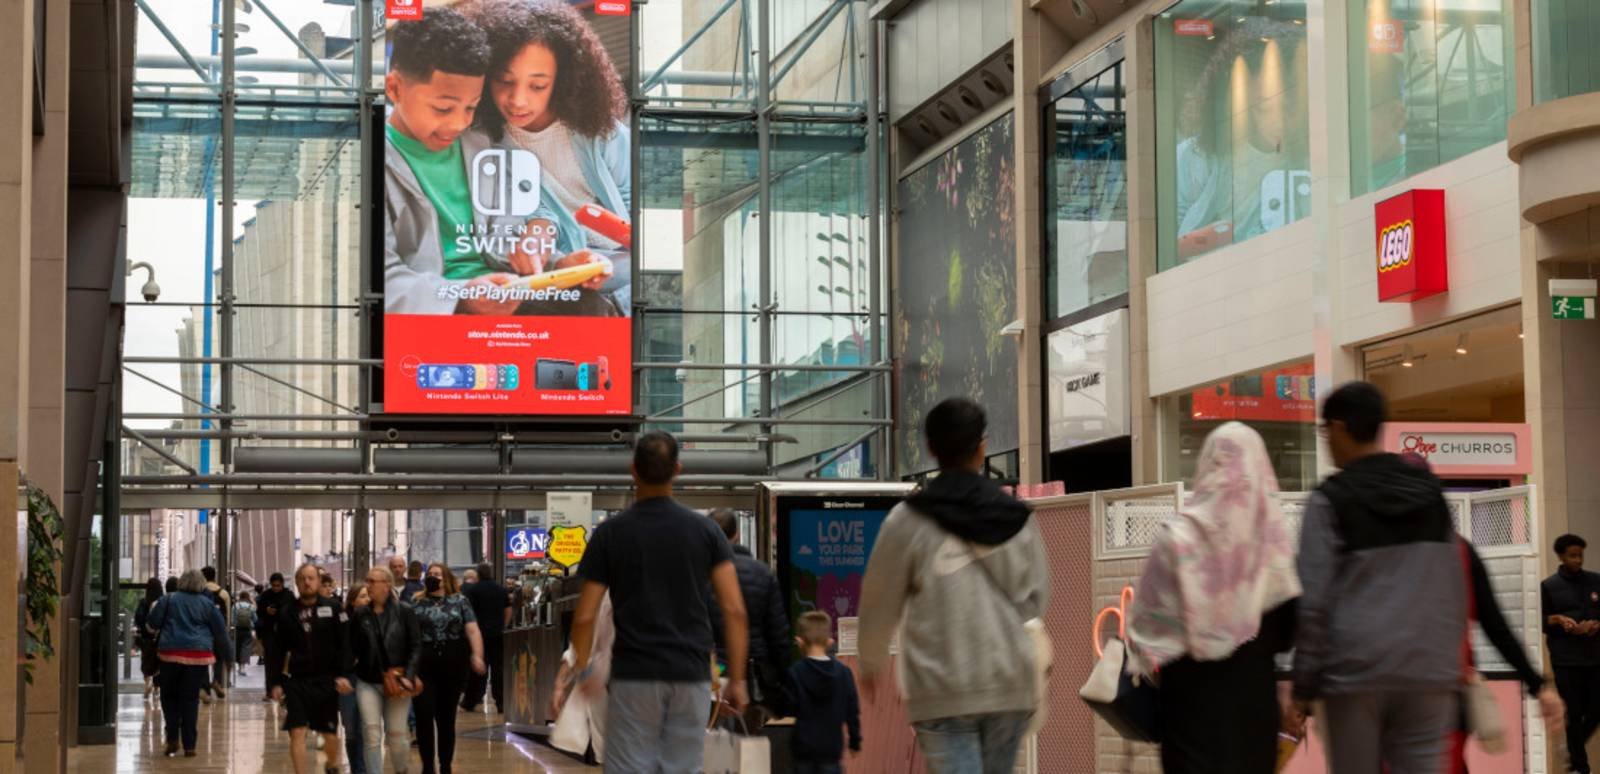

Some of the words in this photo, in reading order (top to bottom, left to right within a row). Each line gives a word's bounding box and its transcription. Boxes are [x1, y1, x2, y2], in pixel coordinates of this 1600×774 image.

[456, 223, 557, 235] NINTENDO
[456, 236, 557, 255] SWITCH
[1380, 223, 1412, 269] LEGO
[437, 285, 581, 303] #SetPlaytimeFree
[1441, 443, 1513, 454] CHURROS
[818, 520, 865, 544] LOVE
